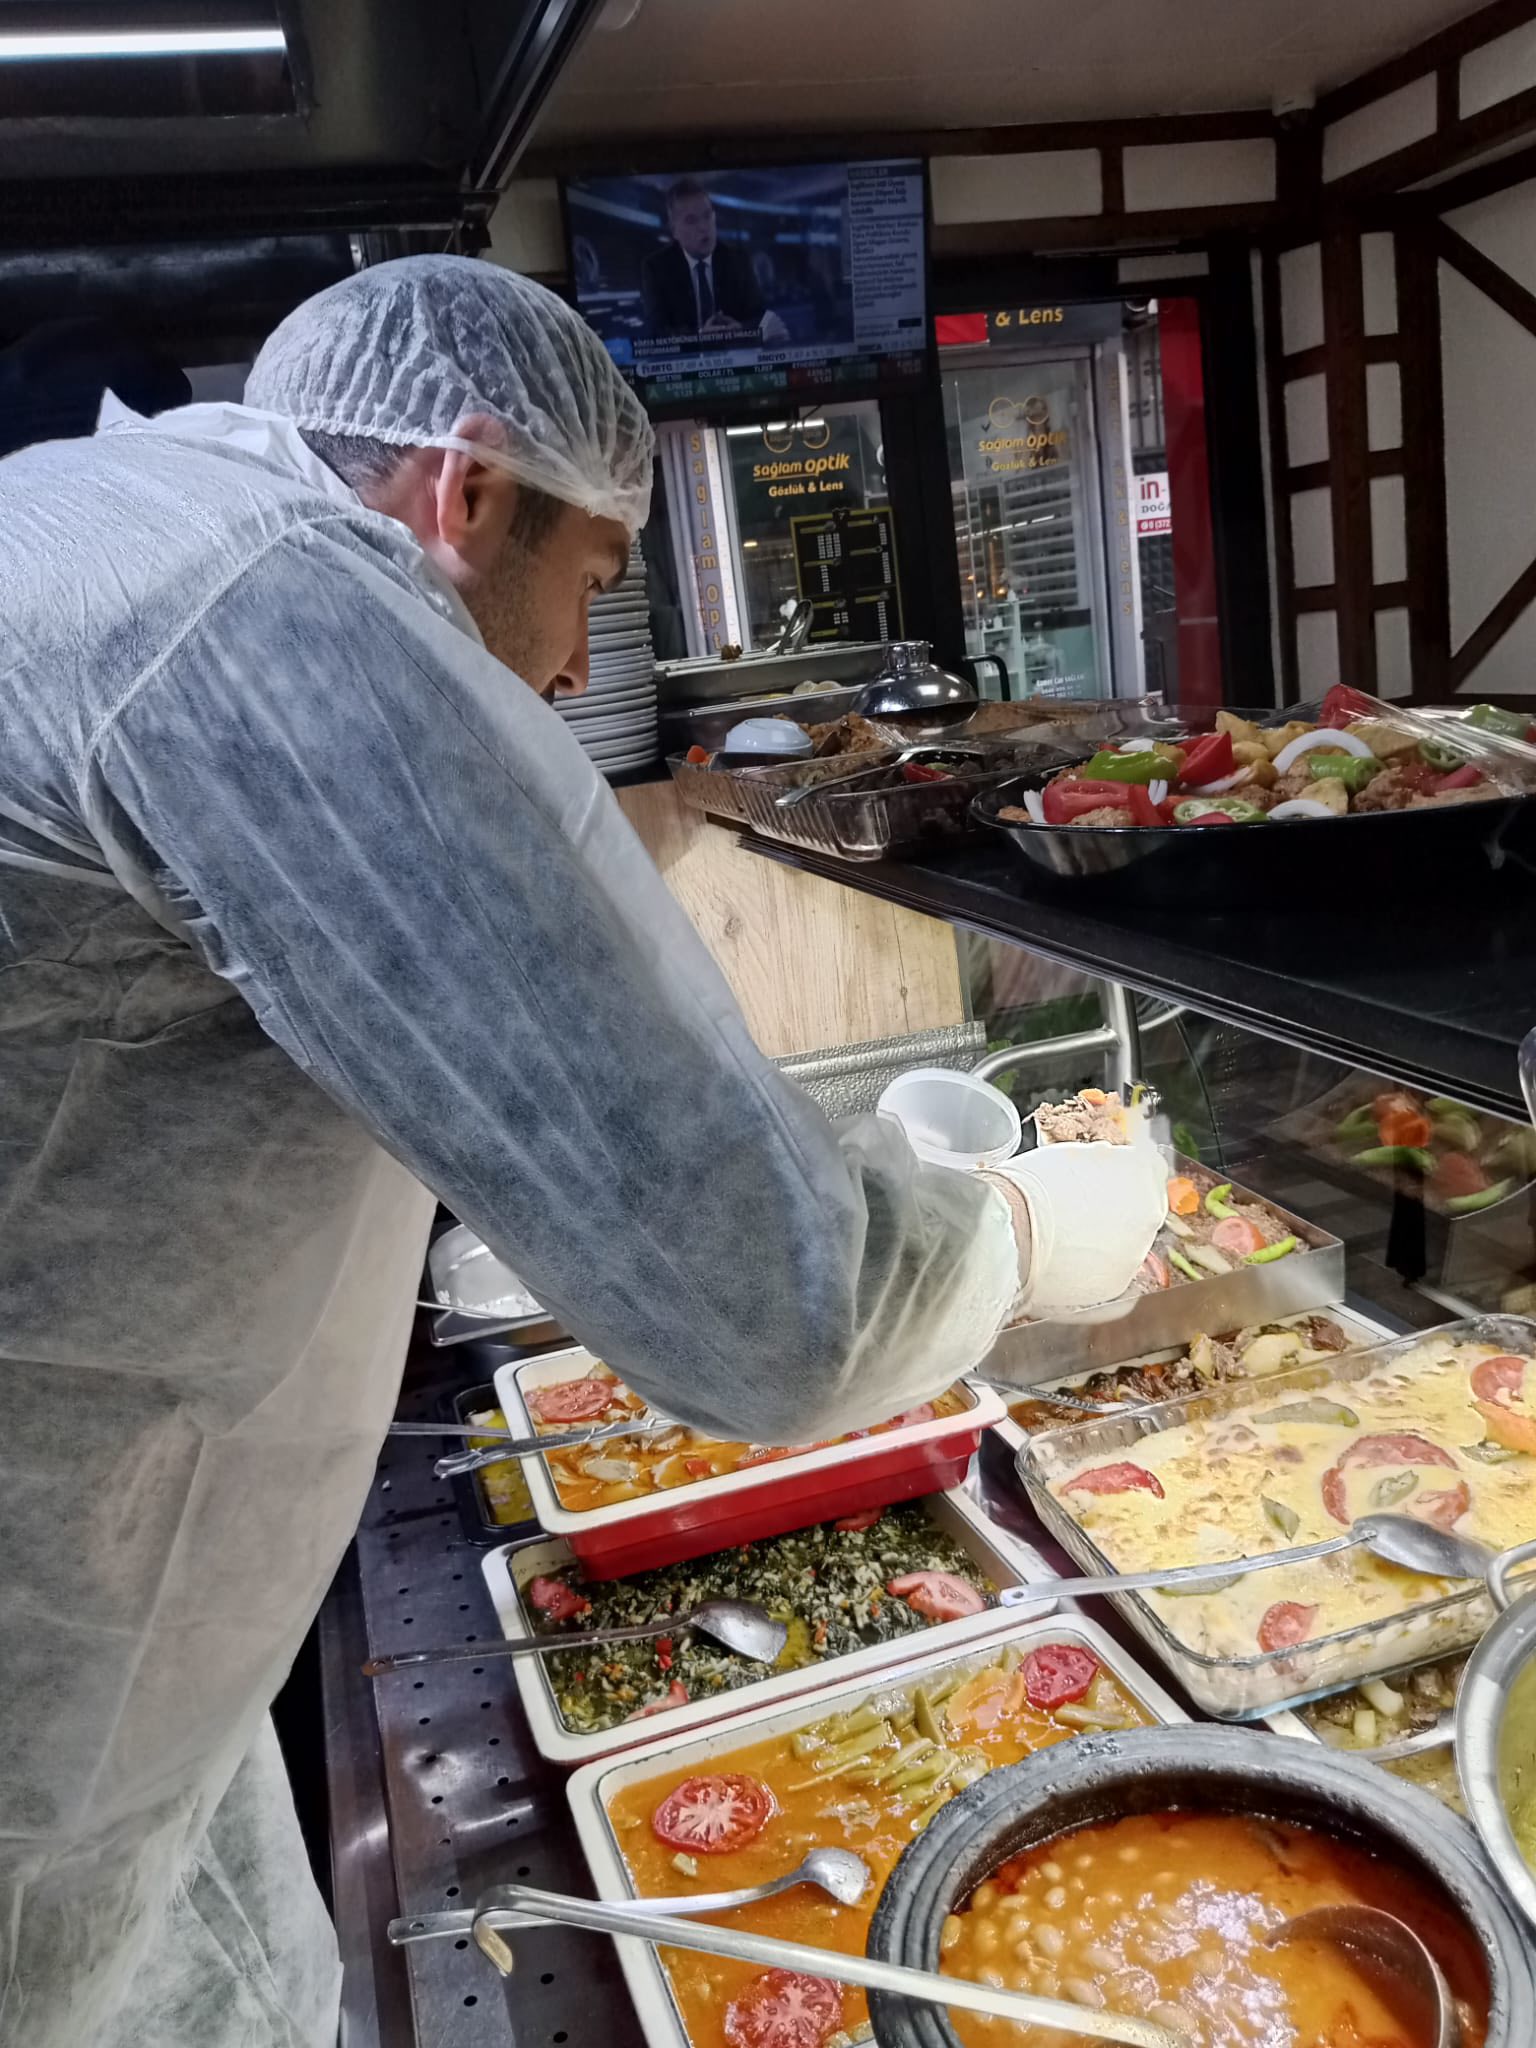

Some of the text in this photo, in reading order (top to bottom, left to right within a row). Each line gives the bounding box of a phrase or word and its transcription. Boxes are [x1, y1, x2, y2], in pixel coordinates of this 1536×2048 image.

[995, 307, 1064, 327] & Lens
[804, 453, 850, 477] optik
[768, 479, 844, 497] Gözlük & Lens
